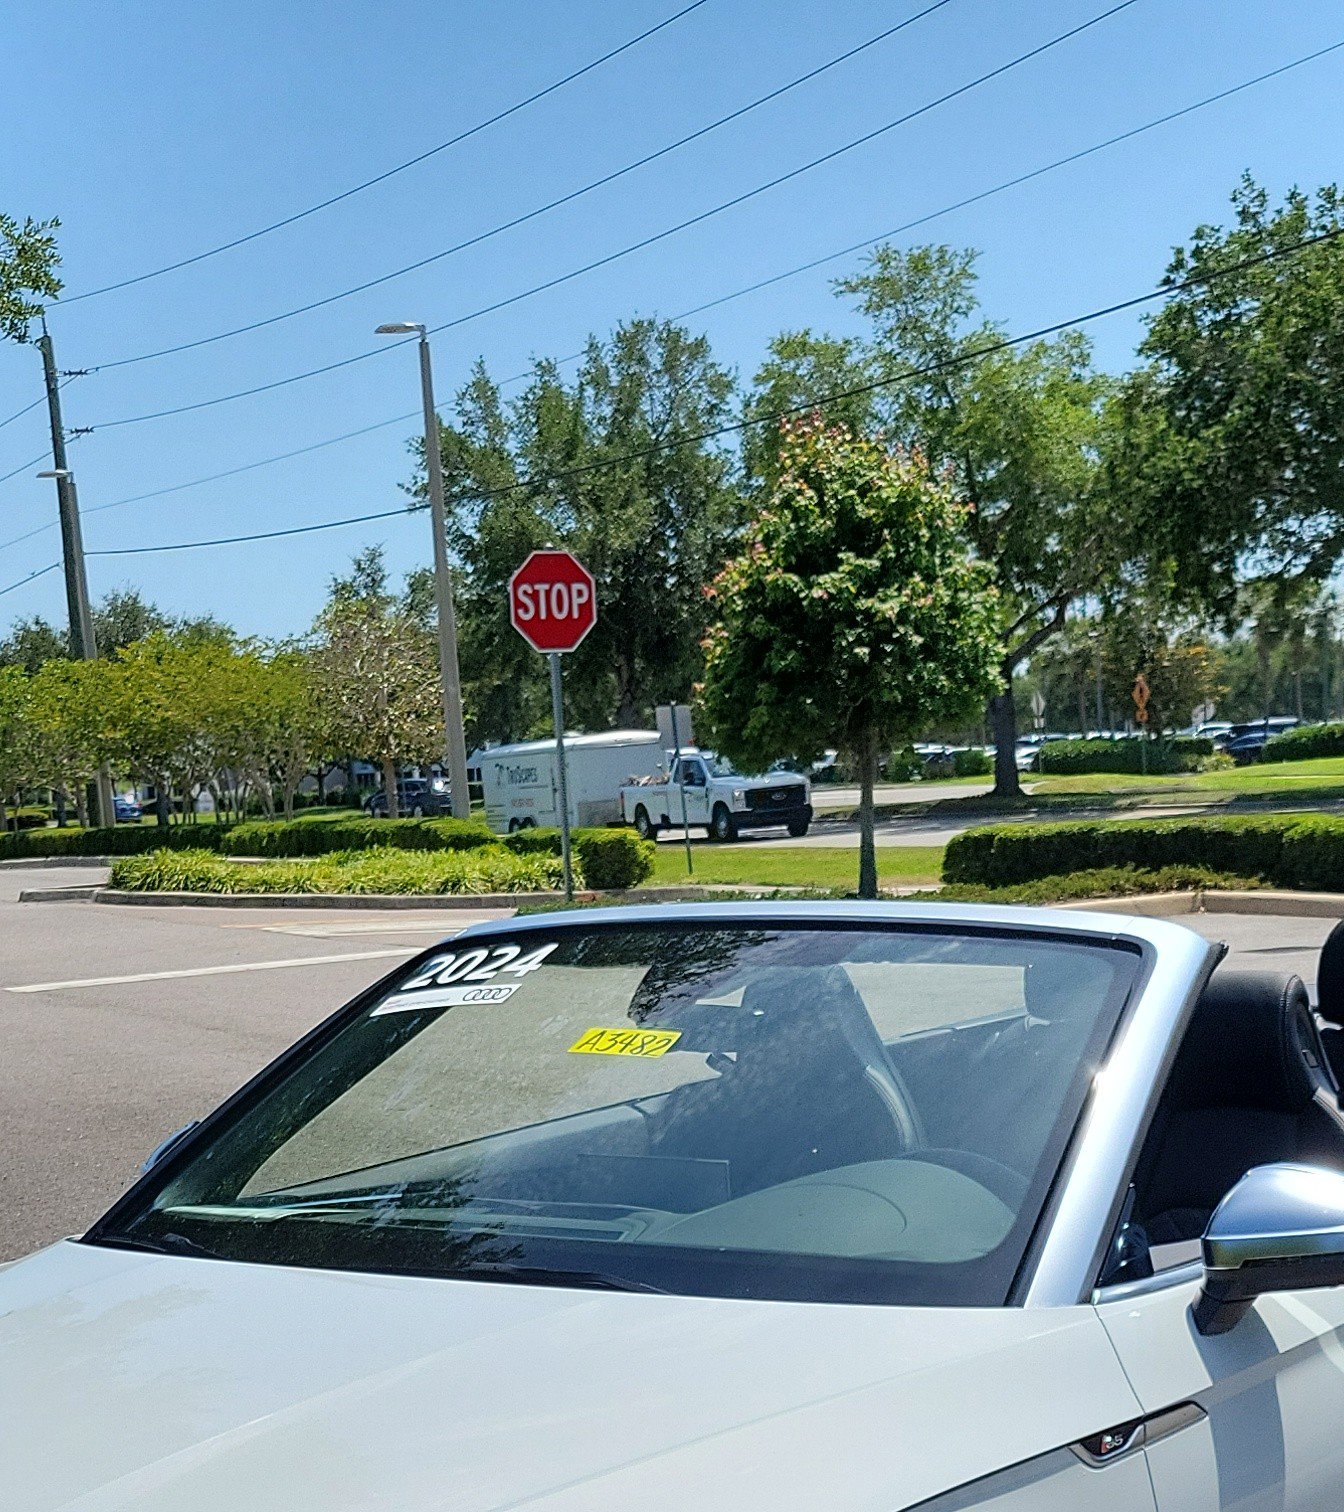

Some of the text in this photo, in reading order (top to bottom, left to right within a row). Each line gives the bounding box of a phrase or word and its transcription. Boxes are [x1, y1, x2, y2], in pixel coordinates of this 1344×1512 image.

[517, 583, 589, 621] STOP
[400, 943, 559, 991] 2024
[576, 1030, 672, 1057] A3482
